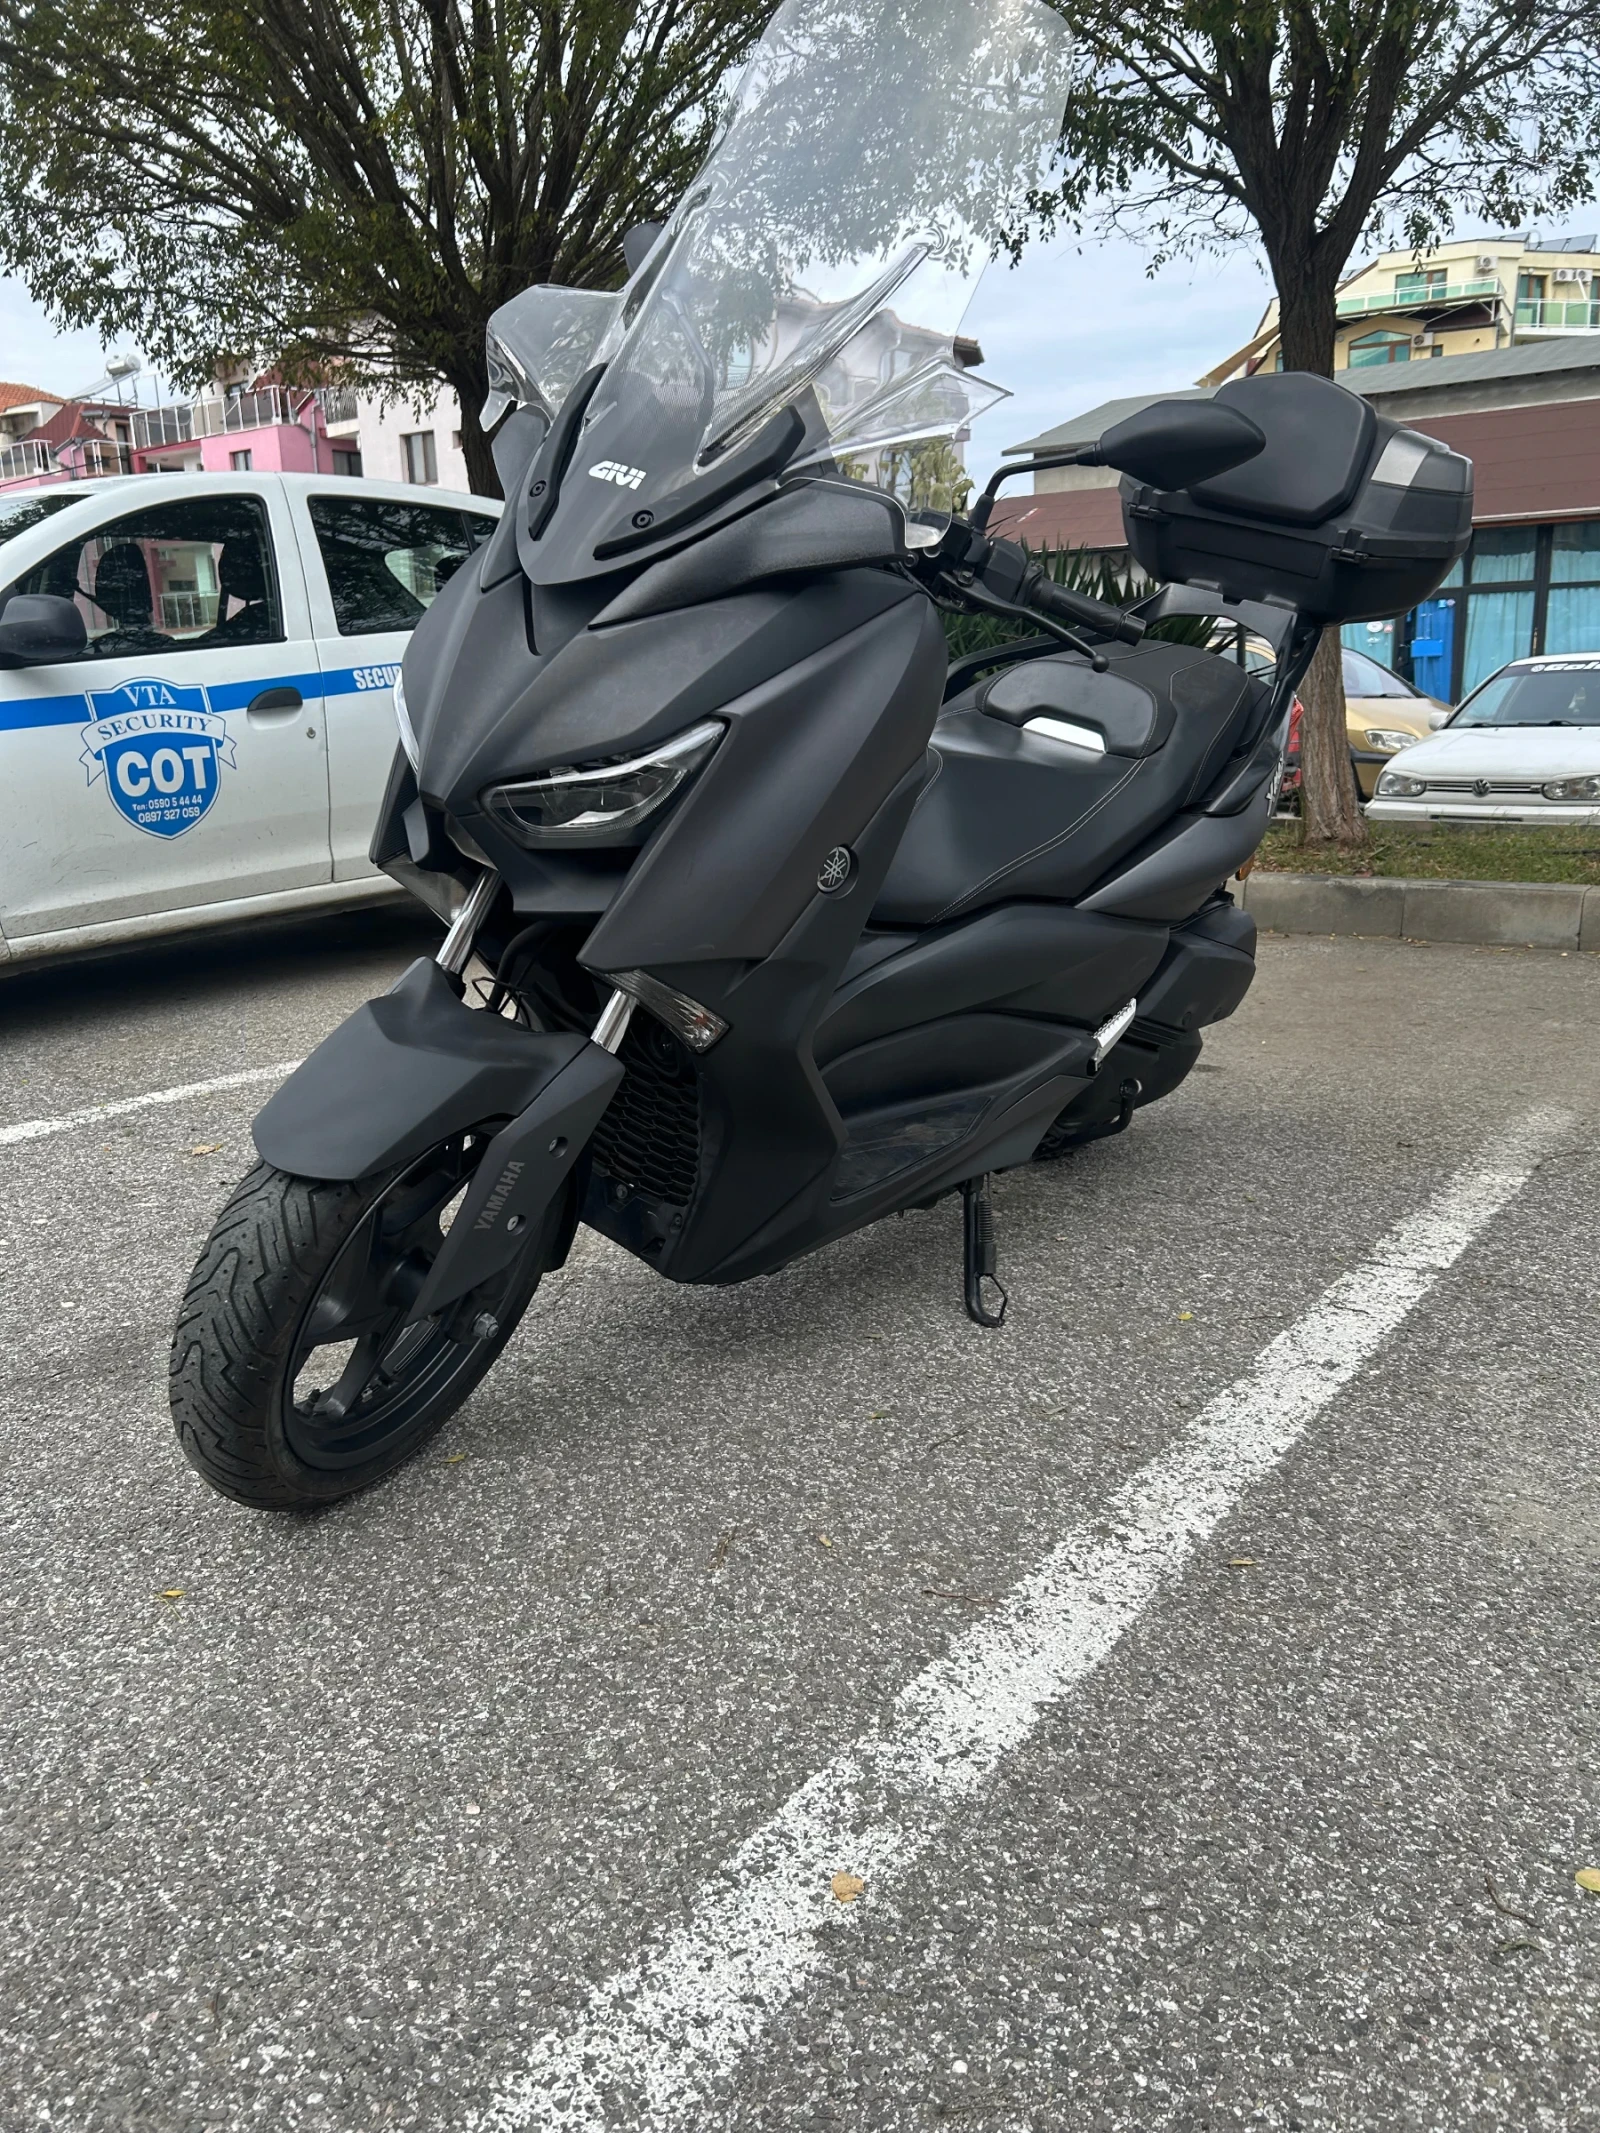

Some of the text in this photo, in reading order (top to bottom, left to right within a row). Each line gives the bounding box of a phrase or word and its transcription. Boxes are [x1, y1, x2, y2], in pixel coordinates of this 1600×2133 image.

[588, 460, 647, 490] GIVI
[122, 685, 177, 708] VTA
[97, 713, 212, 741] SECURITY
[138, 806, 200, 823] 0897 327 059
[148, 798, 170, 810] 0590
[171, 797, 178, 807] 5
[179, 795, 190, 806] 44
[191, 794, 202, 805] 44
[473, 1161, 525, 1230] YAMAHA
